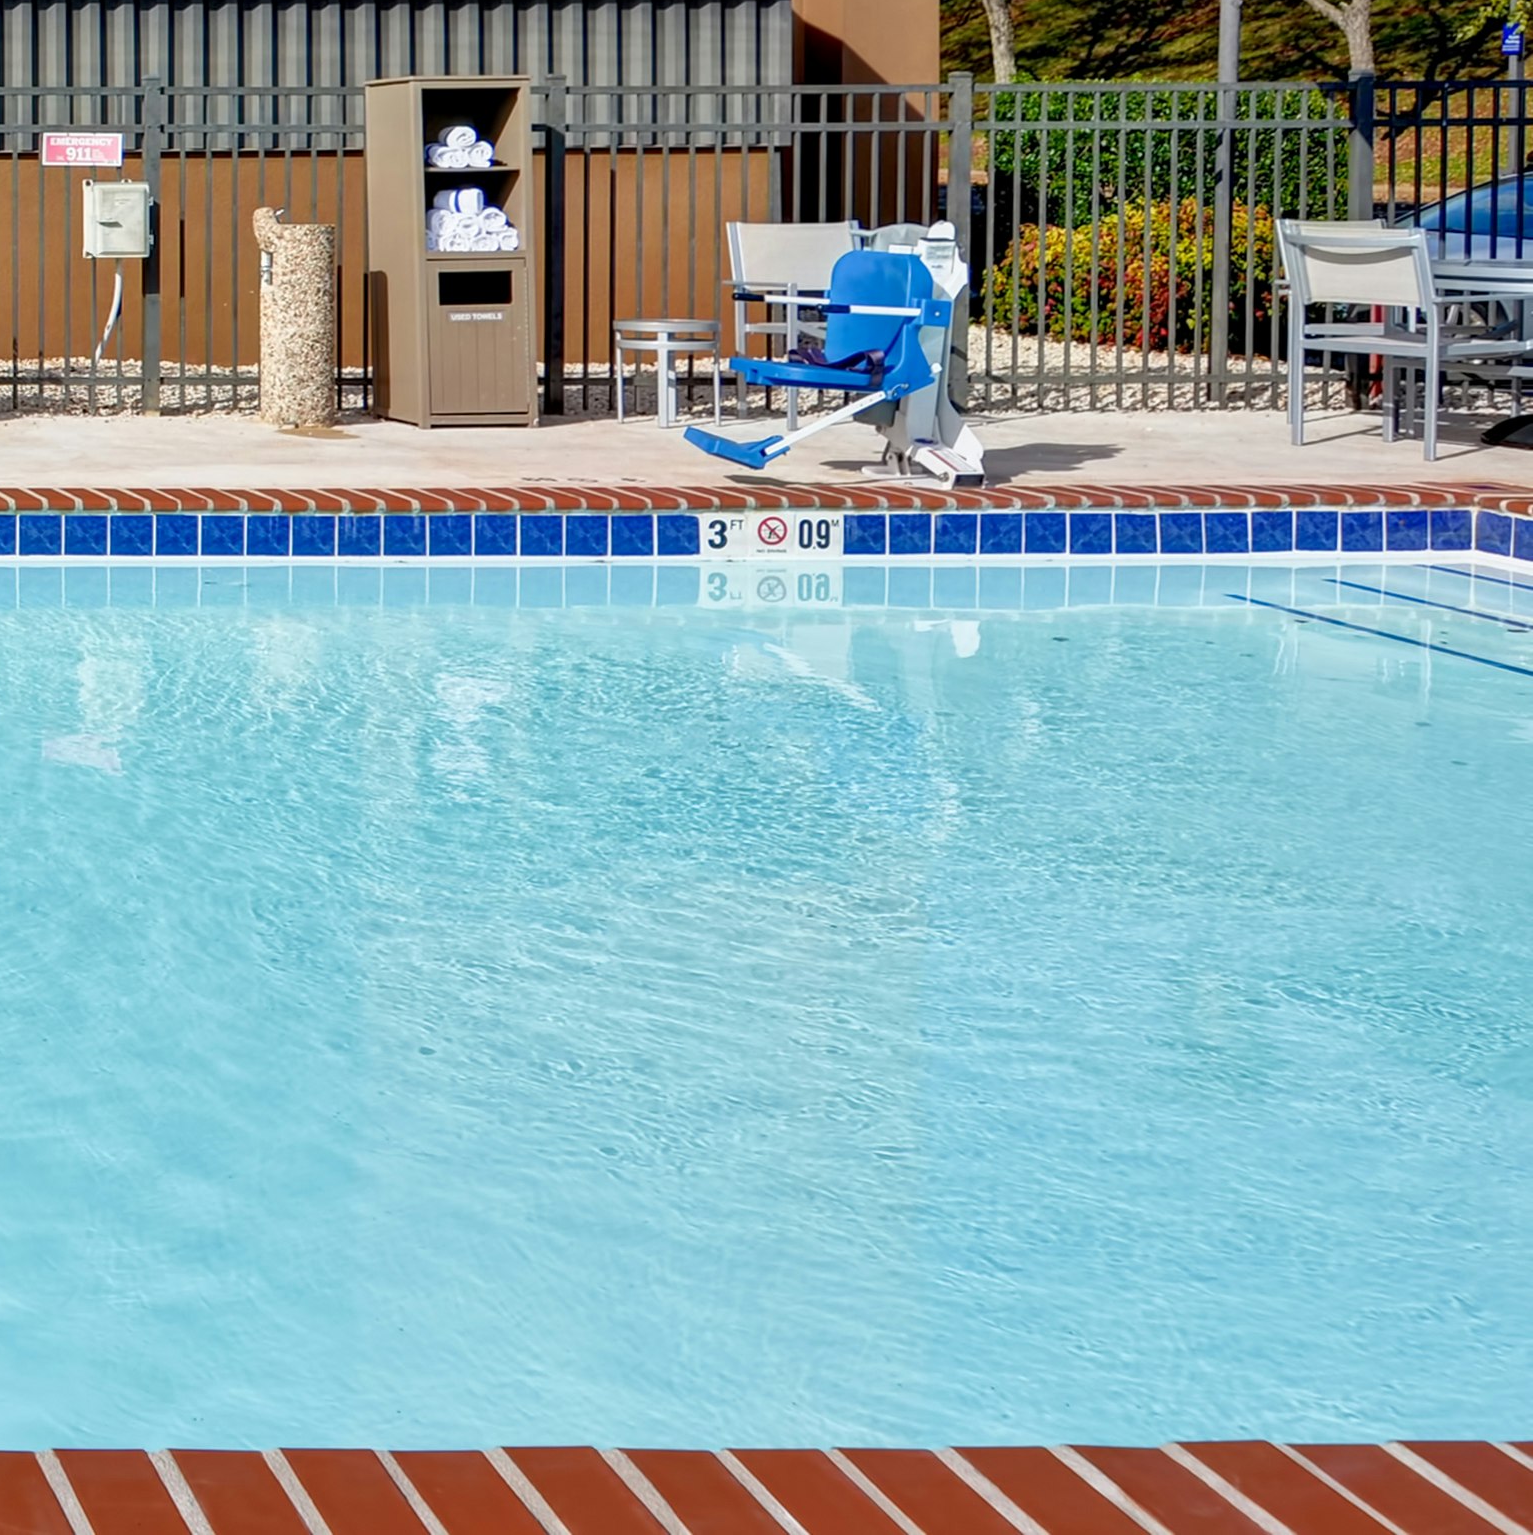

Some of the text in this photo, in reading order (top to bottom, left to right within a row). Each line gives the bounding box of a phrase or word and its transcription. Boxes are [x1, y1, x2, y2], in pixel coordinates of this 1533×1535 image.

[50, 137, 113, 146] EMERGENCY
[65, 147, 92, 161] 911
[450, 312, 502, 321] USED TOWELS
[707, 519, 745, 549] 3 FT
